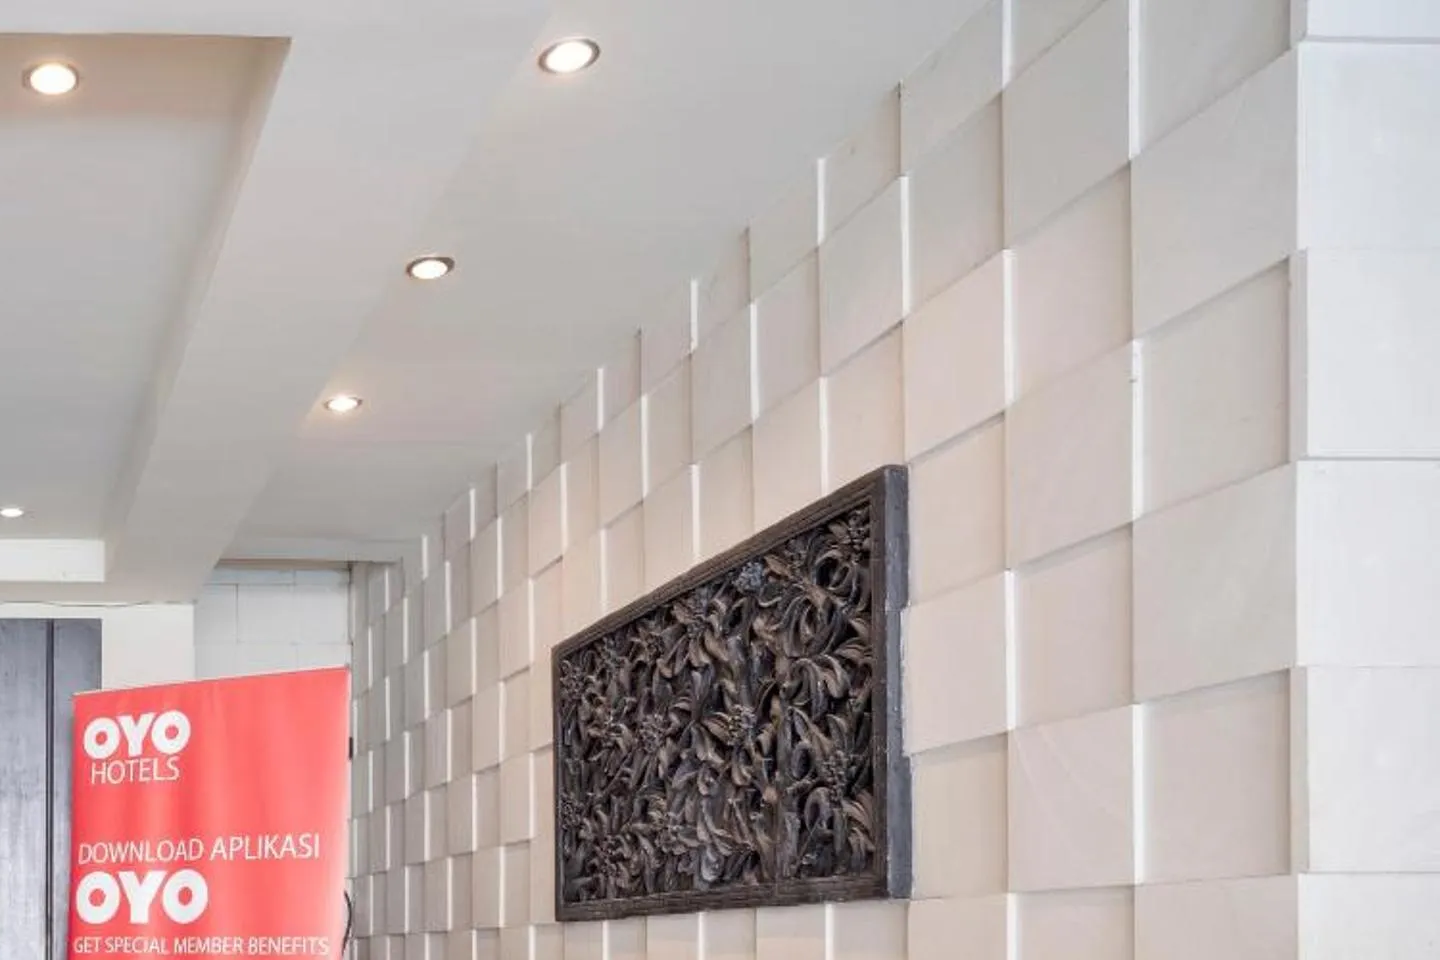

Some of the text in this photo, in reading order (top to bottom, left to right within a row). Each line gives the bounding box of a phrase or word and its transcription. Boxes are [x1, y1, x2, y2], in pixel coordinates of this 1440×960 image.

[83, 709, 191, 760] OYO
[91, 756, 181, 785] HOTELS
[78, 833, 320, 865] DOWNLOAD APLIKASI
[75, 868, 209, 925] OYO
[73, 936, 330, 956] GET SPECIAL MEMBER BENEFITS
